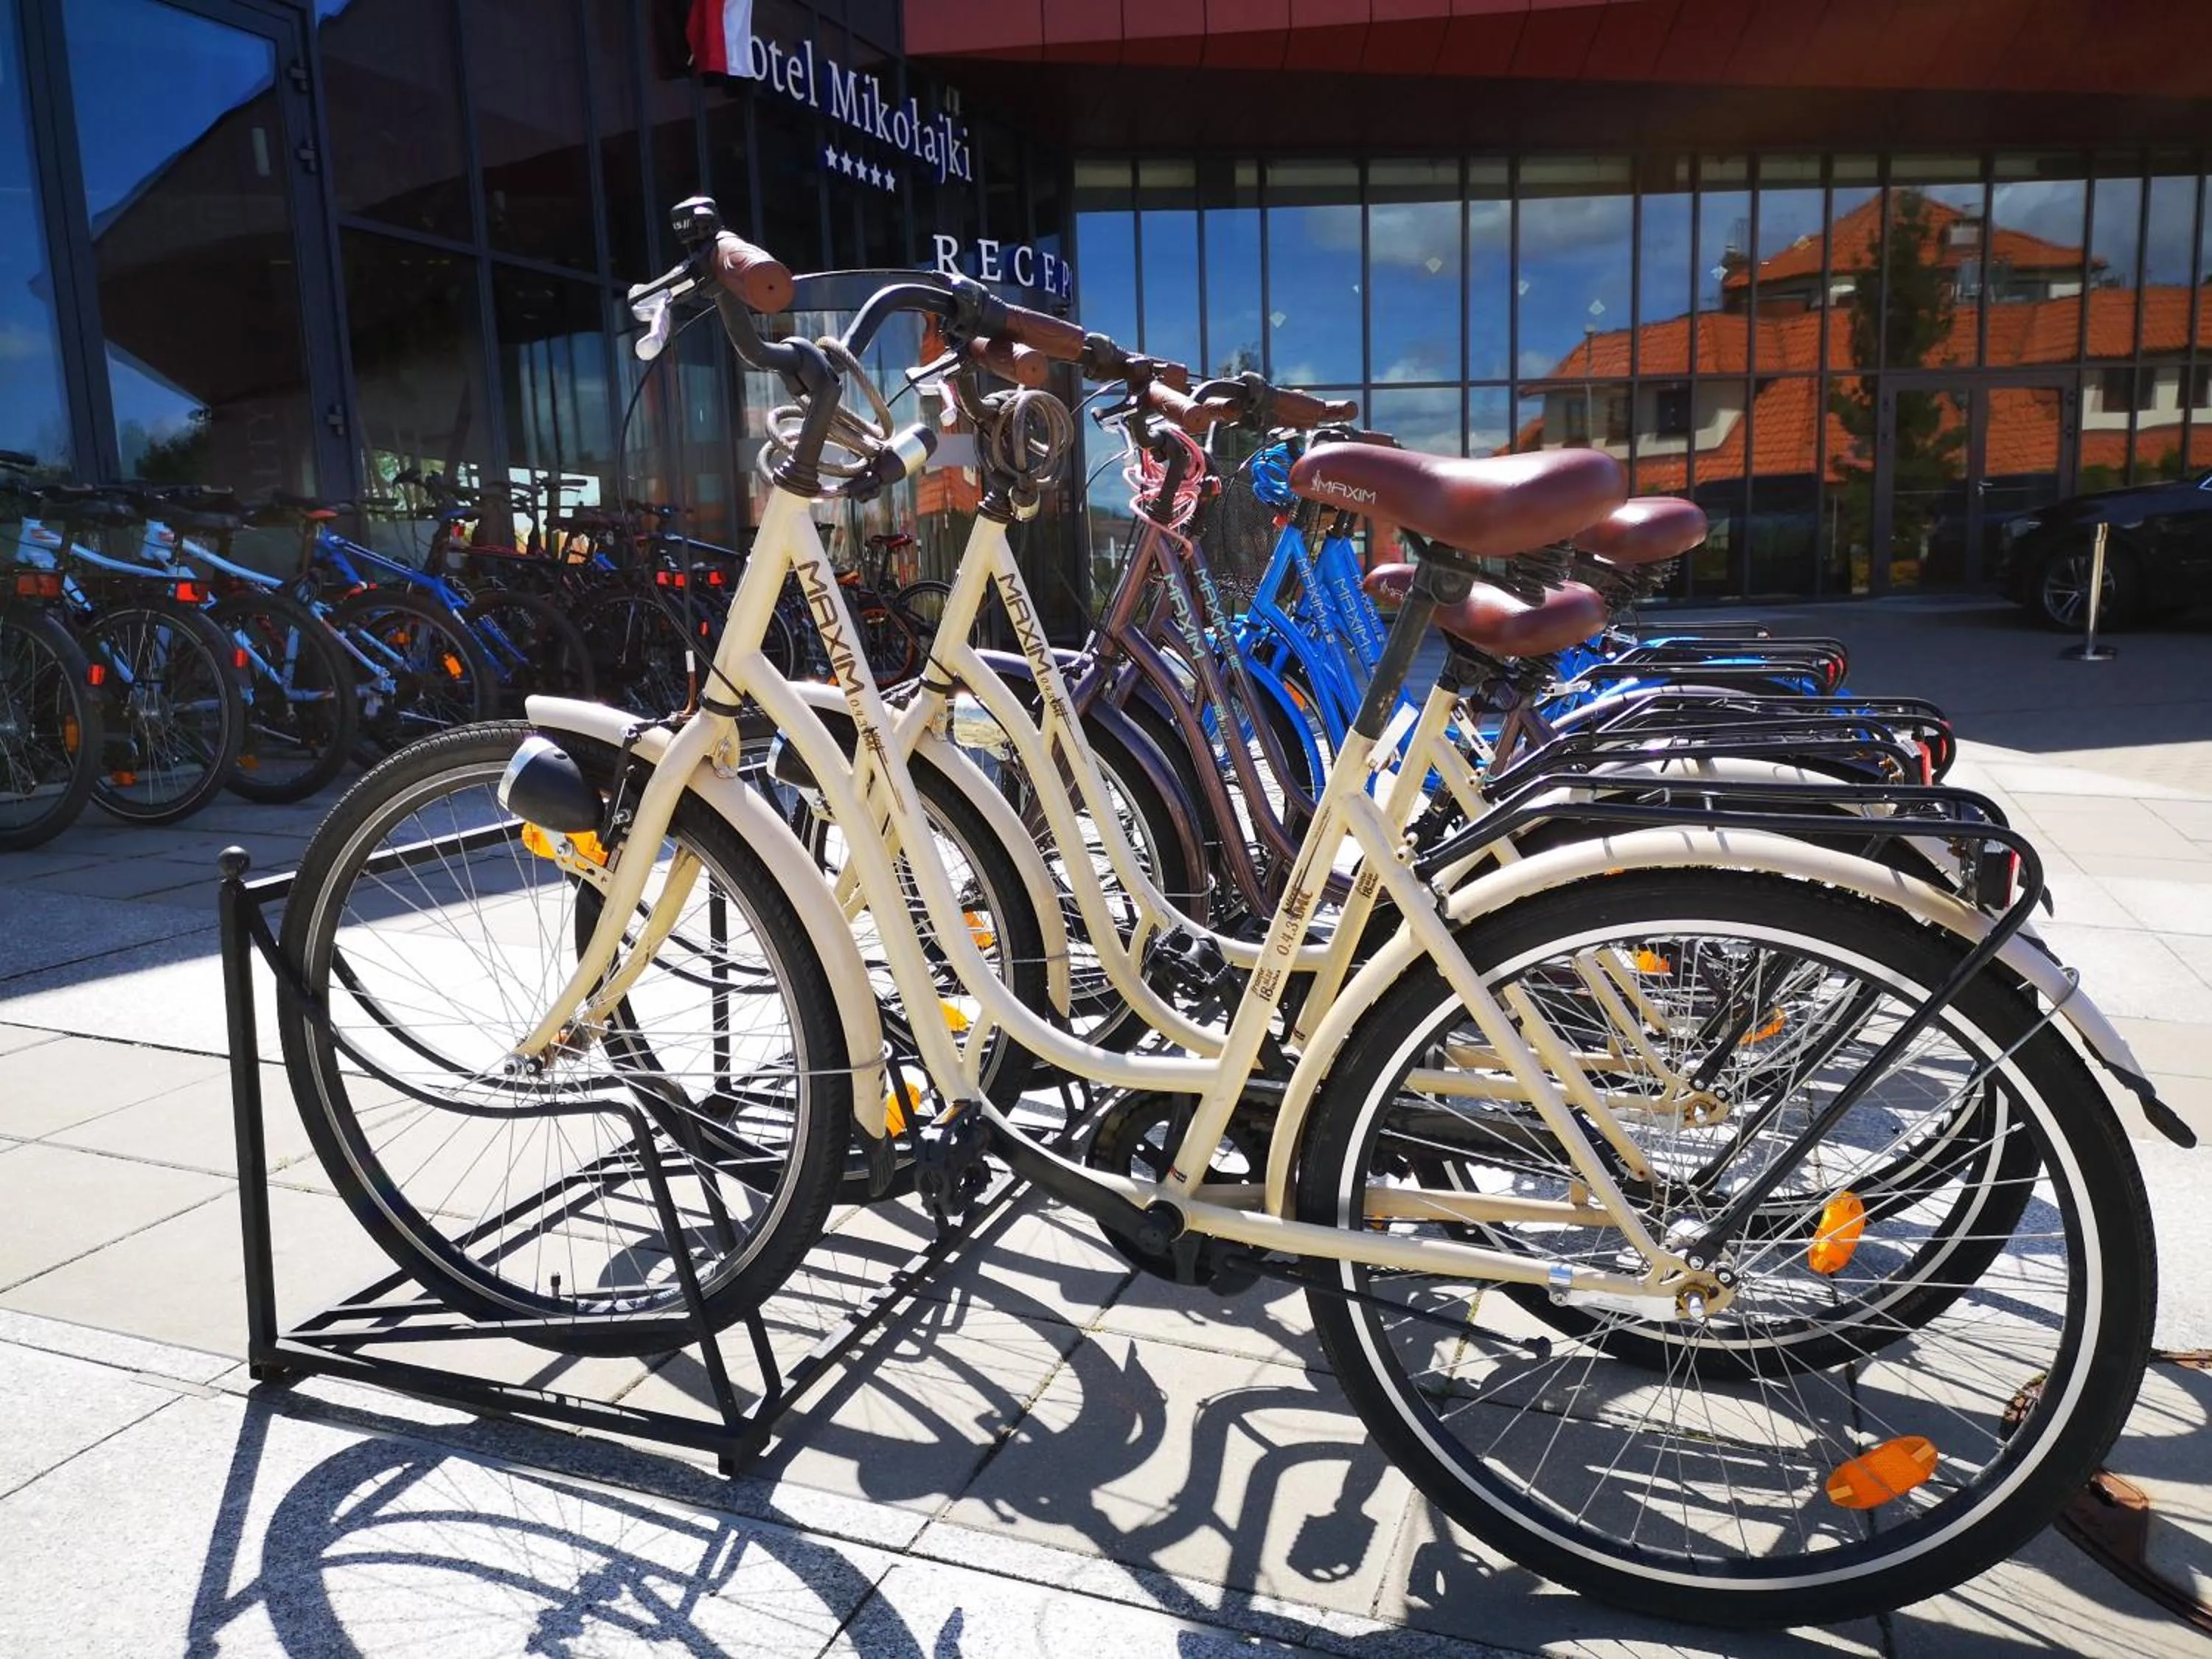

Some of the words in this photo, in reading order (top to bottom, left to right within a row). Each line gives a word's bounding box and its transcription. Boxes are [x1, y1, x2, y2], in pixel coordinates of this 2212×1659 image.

[750, 35, 818, 108] otel
[828, 59, 973, 184] Mikołajki
[933, 234, 1073, 302] RECEP
[1317, 479, 1377, 504] MAXIM
[998, 572, 1052, 676] MAXIM
[1163, 573, 1206, 660] MAXIM
[1194, 567, 1231, 639] MAXIM
[1297, 557, 1328, 620] MAXIM
[1333, 577, 1371, 647] MAXIM
[798, 560, 865, 697] MAXIM
